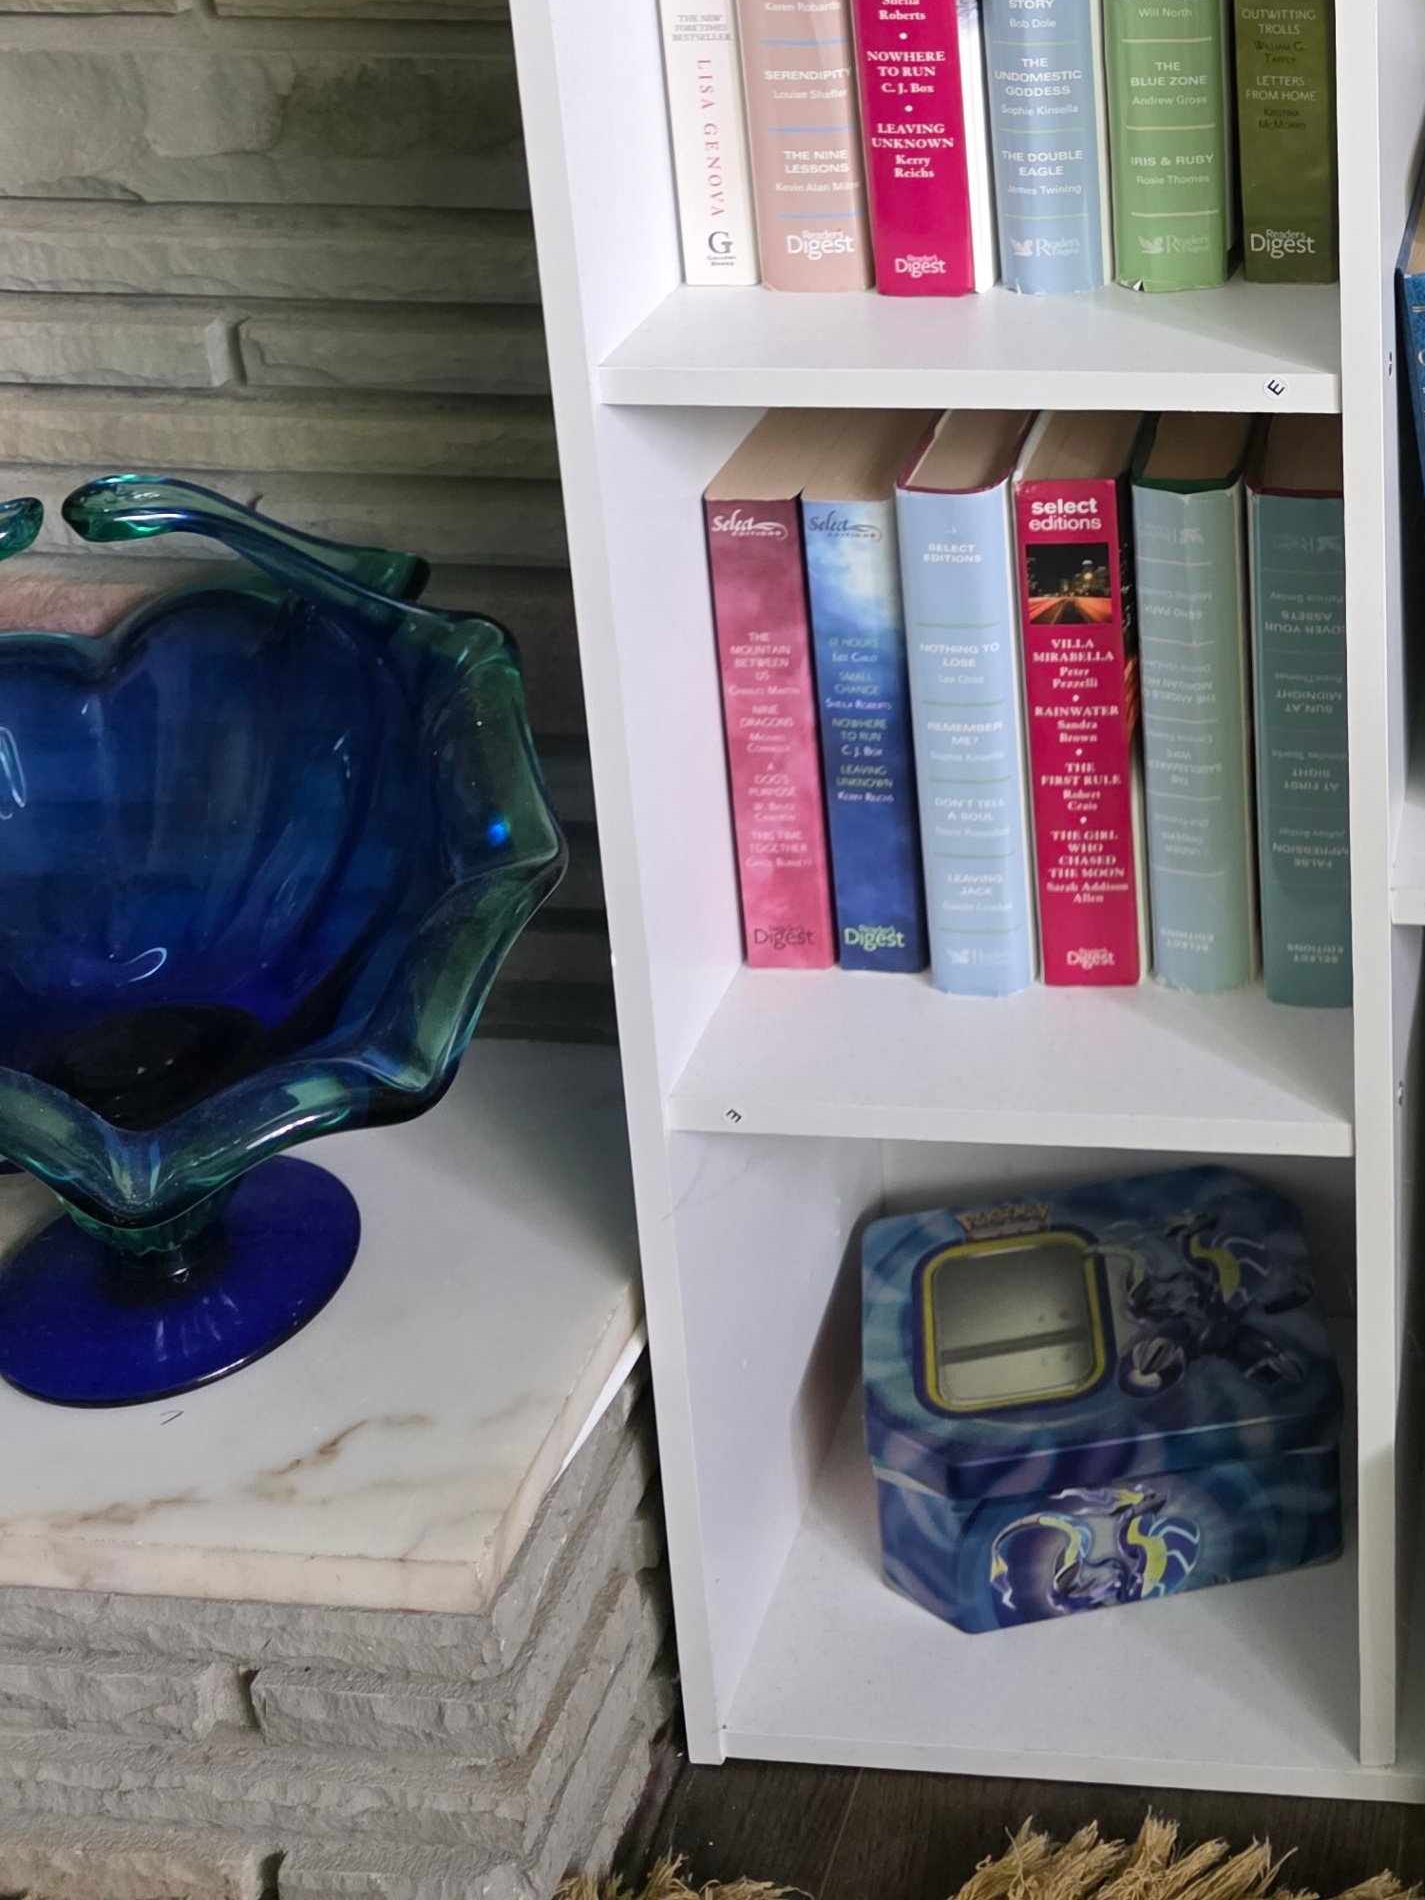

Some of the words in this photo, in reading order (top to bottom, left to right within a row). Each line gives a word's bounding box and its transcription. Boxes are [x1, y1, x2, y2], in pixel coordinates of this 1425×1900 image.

[1008, 0, 1055, 10] STORY
[878, 9, 927, 21] Roberts
[1241, 8, 1317, 21] OUTWITTING
[1258, 23, 1300, 35] TROLLS
[866, 50, 946, 62] NOWHERE
[1021, 57, 1049, 68] THE
[994, 69, 1082, 83] UNDOMESTIC
[1130, 76, 1166, 87] BLUE
[1169, 75, 1208, 86] ZONE
[1256, 75, 1305, 87] LETTERS
[697, 59, 716, 109] LISA
[1005, 85, 1071, 97] GODDESS
[1246, 89, 1279, 101] FROM
[1281, 90, 1317, 101] HOME
[876, 123, 945, 134] LEAVING
[871, 137, 954, 148] UNKNOWN
[703, 122, 725, 217] GENOVA
[785, 162, 850, 174] LESSONS
[1018, 165, 1064, 176] EAGLE
[786, 235, 856, 261] Digest
[1250, 232, 1316, 260] Digest
[1030, 497, 1098, 515] select
[1028, 515, 1102, 531] editions
[928, 543, 976, 553] SELECT
[923, 554, 982, 563] EDITIONS
[1281, 610, 1333, 621] ASSETS
[919, 642, 979, 654] NOTHING
[981, 641, 1000, 652] TO
[1051, 638, 1095, 649] VILLA
[1032, 651, 1114, 662] MIRABELLA
[942, 658, 977, 668] LOSE
[1276, 689, 1343, 700] MIDNIGHT
[1034, 705, 1119, 717] RAINWATER
[927, 721, 1003, 733] REMEMBER
[1064, 762, 1096, 773] THE
[1041, 775, 1081, 786] FIRST
[1083, 774, 1122, 785] RULE
[1050, 830, 1082, 841] THE
[1083, 830, 1119, 841] GIRL
[1067, 843, 1103, 853] WHO
[1058, 855, 1117, 866] CHASED
[1048, 867, 1079, 878] THE
[1081, 867, 1125, 878] MOON
[754, 928, 816, 950] Digest
[844, 927, 906, 951] Digest
[1286, 943, 1344, 954] EDITIONS
[1066, 949, 1115, 970] Digest
[1293, 954, 1339, 964] SELECT
